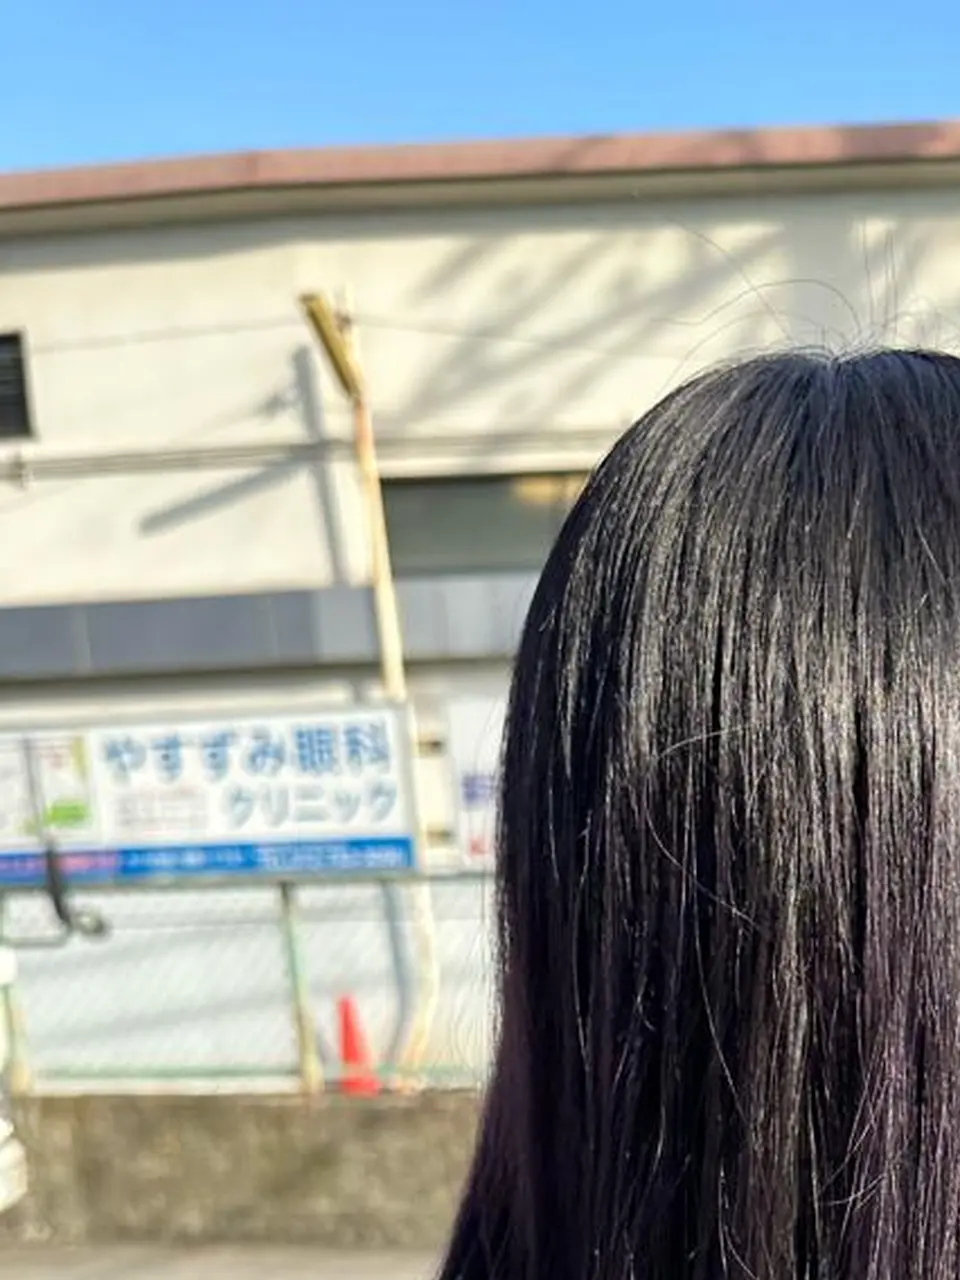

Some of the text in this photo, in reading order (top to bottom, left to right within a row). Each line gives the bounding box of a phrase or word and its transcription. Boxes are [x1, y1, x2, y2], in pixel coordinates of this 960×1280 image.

[223, 783, 396, 828] クリニック
